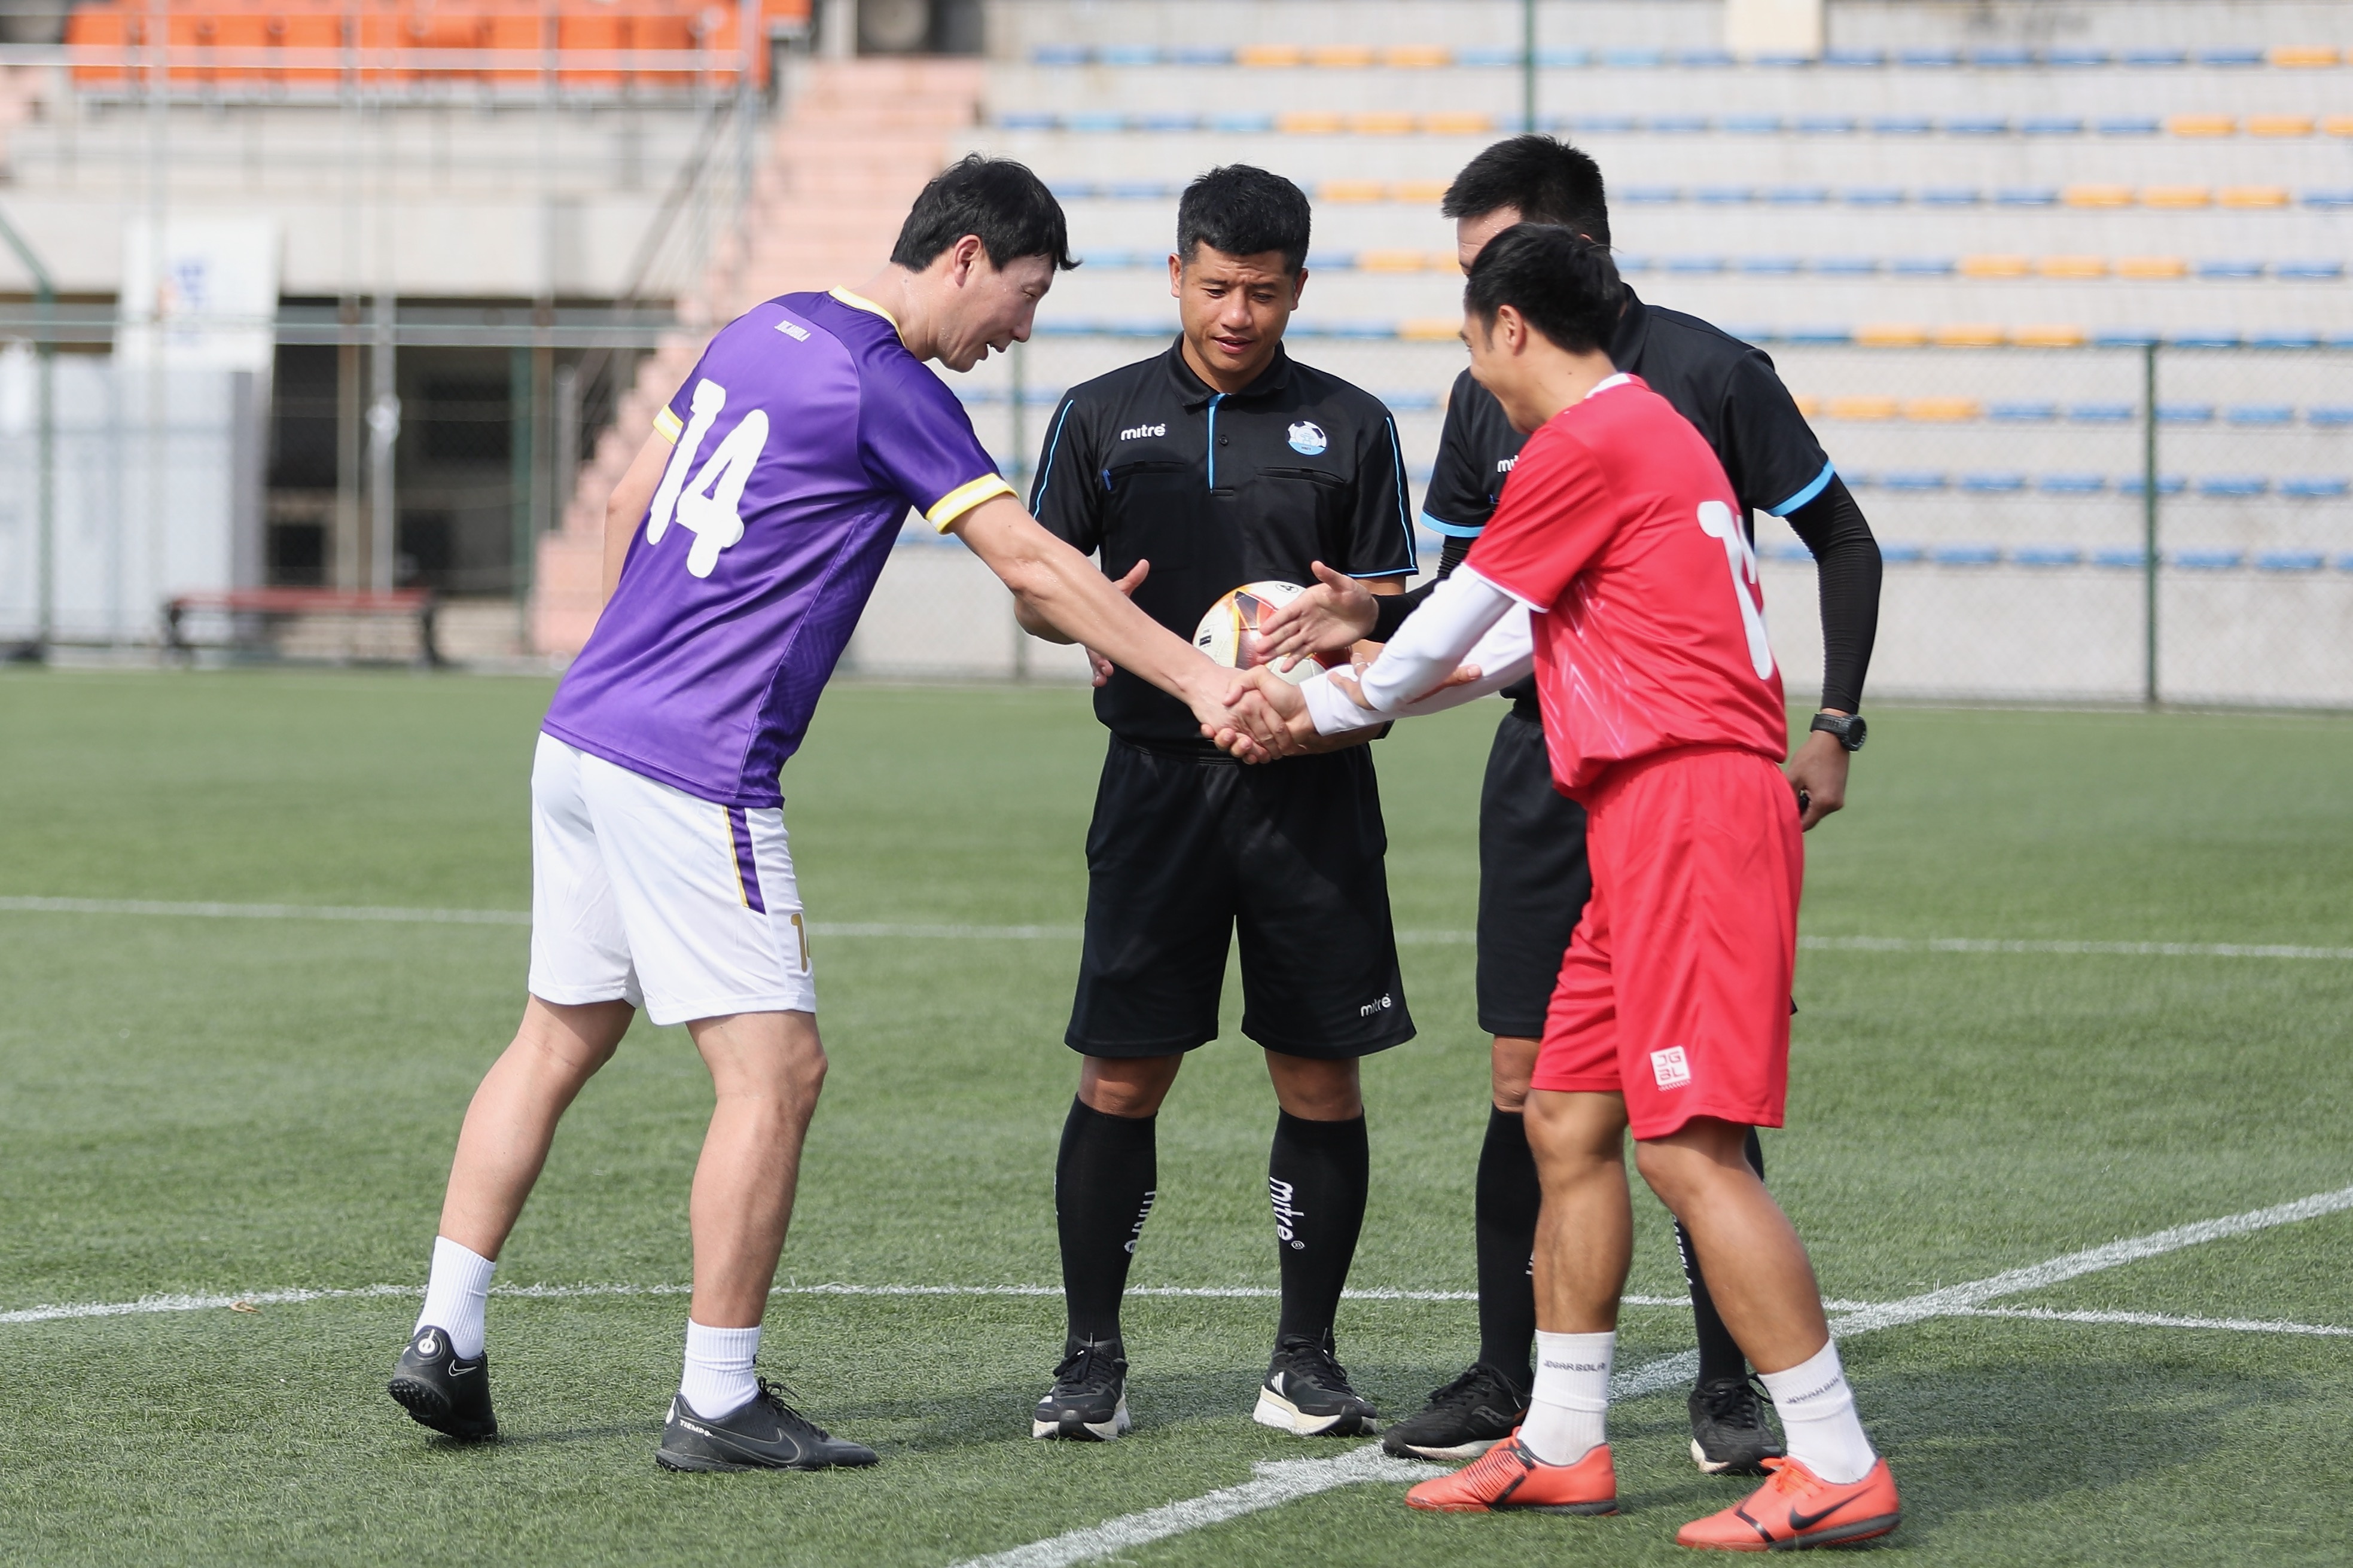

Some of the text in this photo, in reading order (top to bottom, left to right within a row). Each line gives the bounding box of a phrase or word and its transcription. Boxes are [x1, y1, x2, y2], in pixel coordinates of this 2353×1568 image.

[646, 378, 769, 578] 14
[1697, 500, 1773, 680] 1
[679, 1418, 714, 1438] TIEMPO
